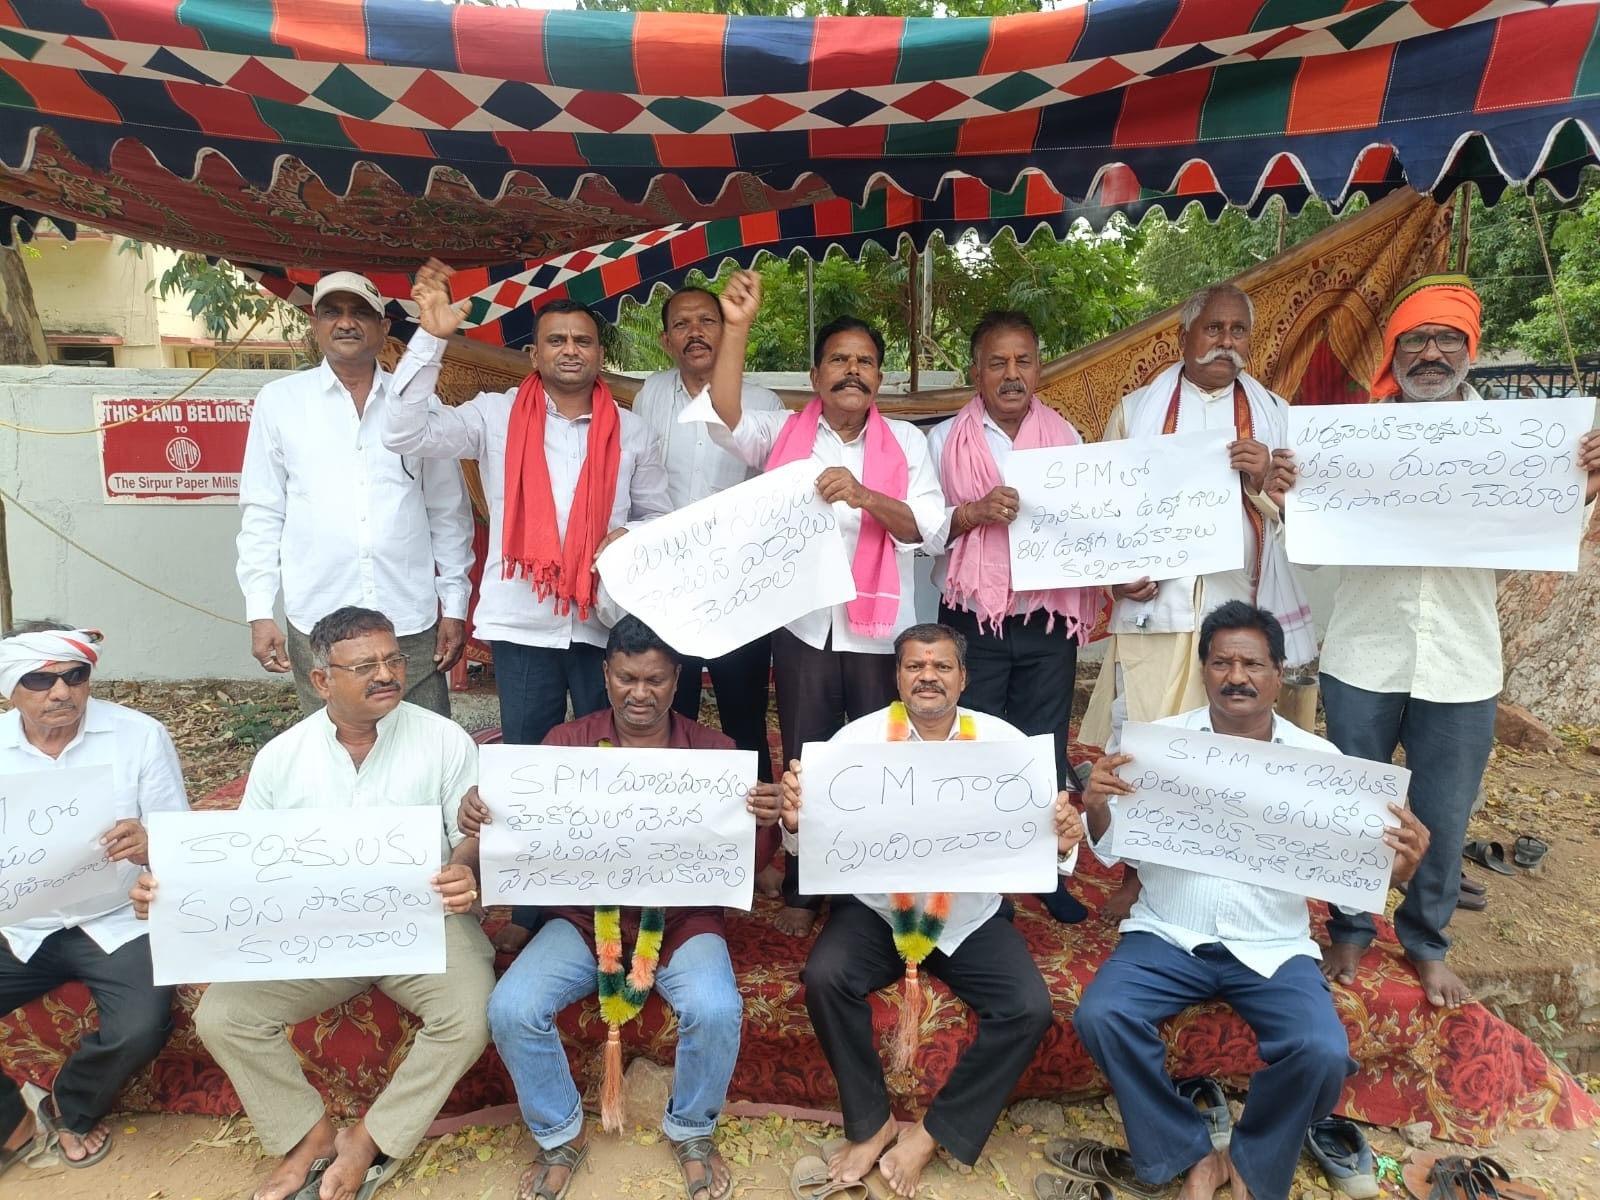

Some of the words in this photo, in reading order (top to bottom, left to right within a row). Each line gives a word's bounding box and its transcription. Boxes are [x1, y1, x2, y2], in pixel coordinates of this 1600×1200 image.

[104, 404, 138, 423] THIS
[142, 404, 183, 423] LAND
[187, 404, 255, 423] BELONGS
[174, 425, 188, 434] TO
[1510, 418, 1566, 449] 30
[114, 477, 136, 489] The
[138, 476, 172, 491] Sirpur
[175, 476, 209, 491] Paper
[212, 477, 239, 489] Mills
[1017, 539, 1049, 562] 80%
